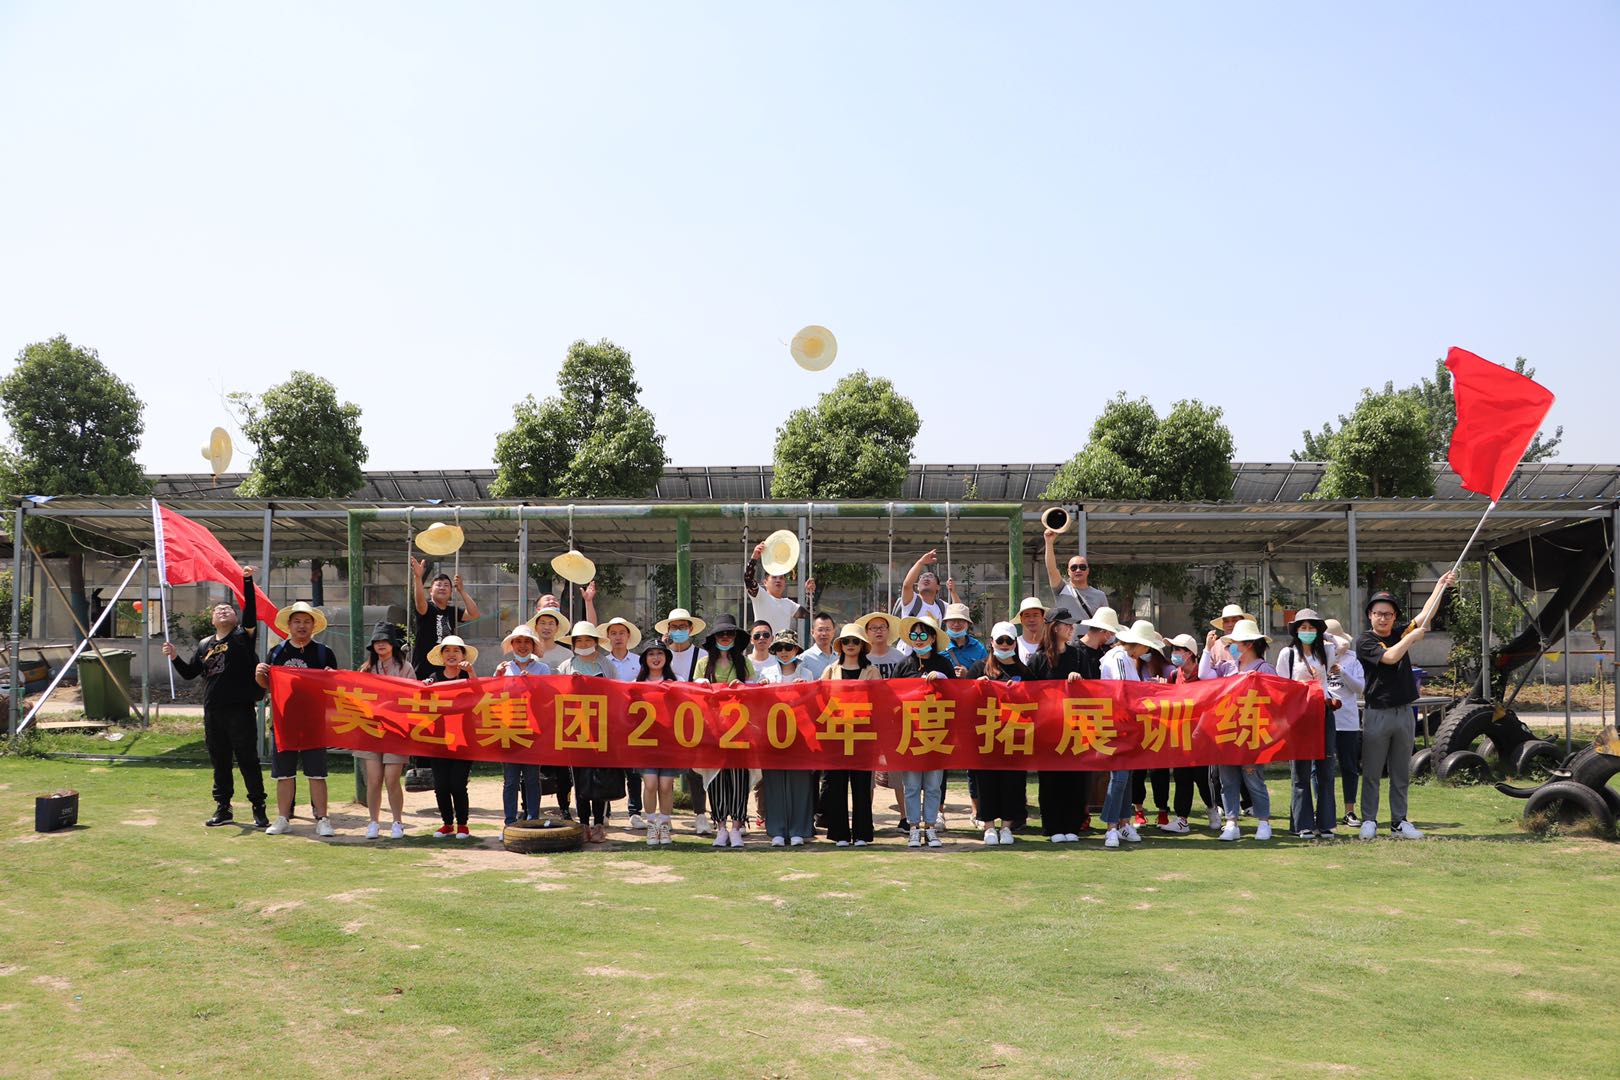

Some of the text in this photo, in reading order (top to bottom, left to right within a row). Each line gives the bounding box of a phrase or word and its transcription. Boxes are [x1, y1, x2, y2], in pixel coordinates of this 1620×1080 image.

[322, 687, 1273, 756] 莫艺集团2020年度拓展训练
